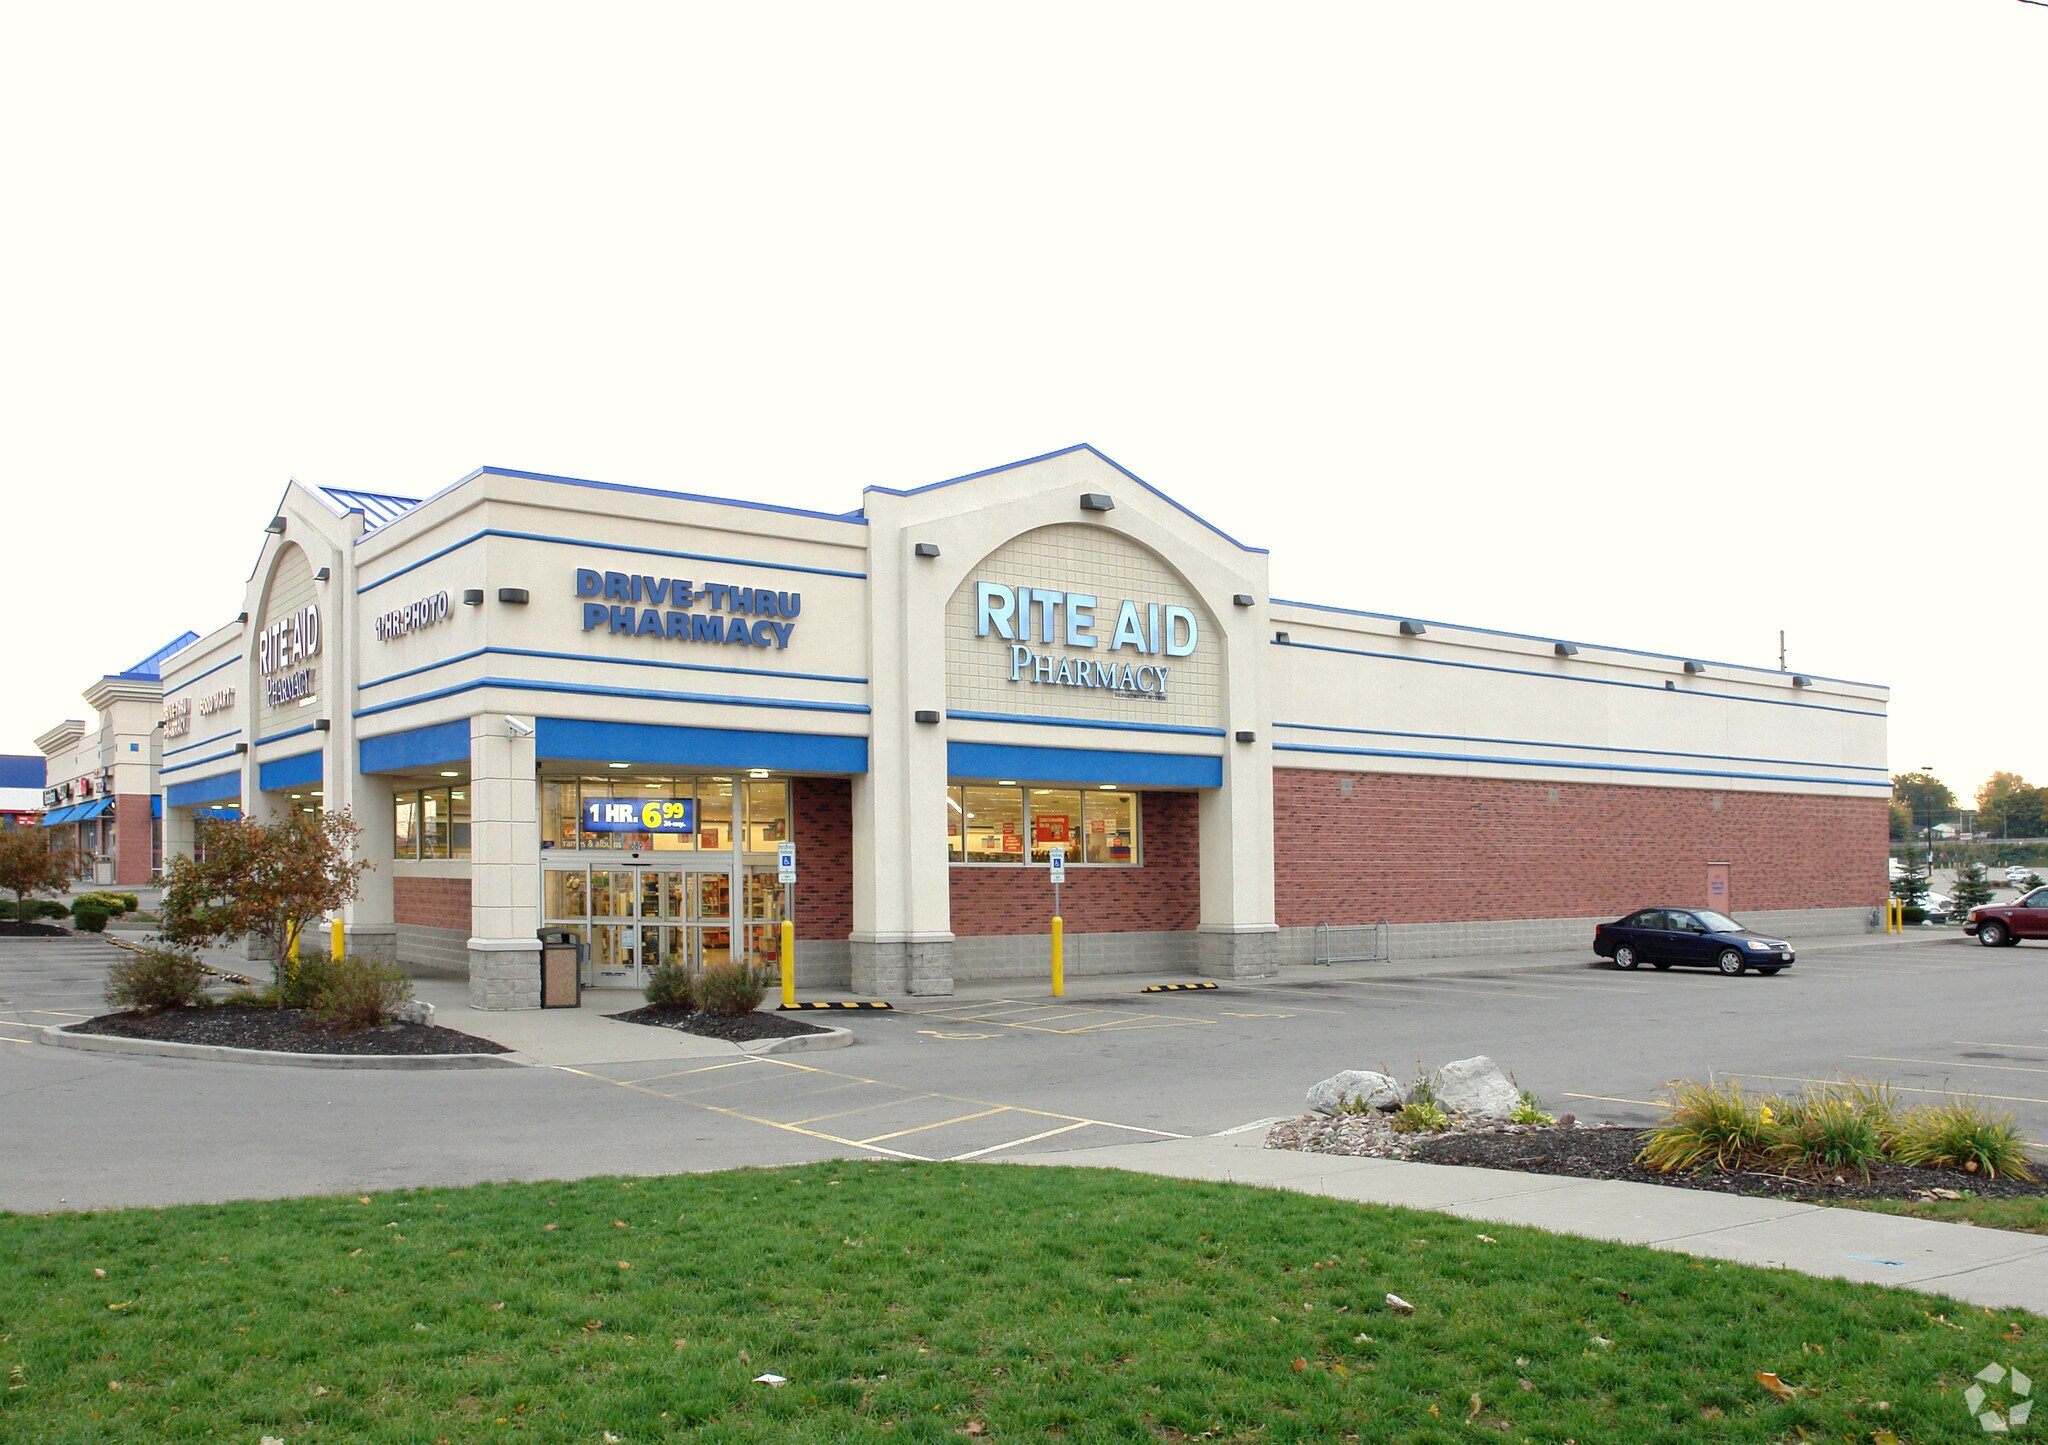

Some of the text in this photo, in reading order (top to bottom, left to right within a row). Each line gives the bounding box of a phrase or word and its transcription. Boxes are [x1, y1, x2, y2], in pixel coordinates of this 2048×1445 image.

[403, 590, 449, 632] PHOTO
[575, 567, 801, 619] DRIVE-THRU
[259, 603, 320, 676] RITE AID
[582, 602, 796, 650] PHARMACY
[975, 580, 1199, 658] RITE AID
[589, 803, 600, 823] 1
[605, 803, 639, 823] HR.
